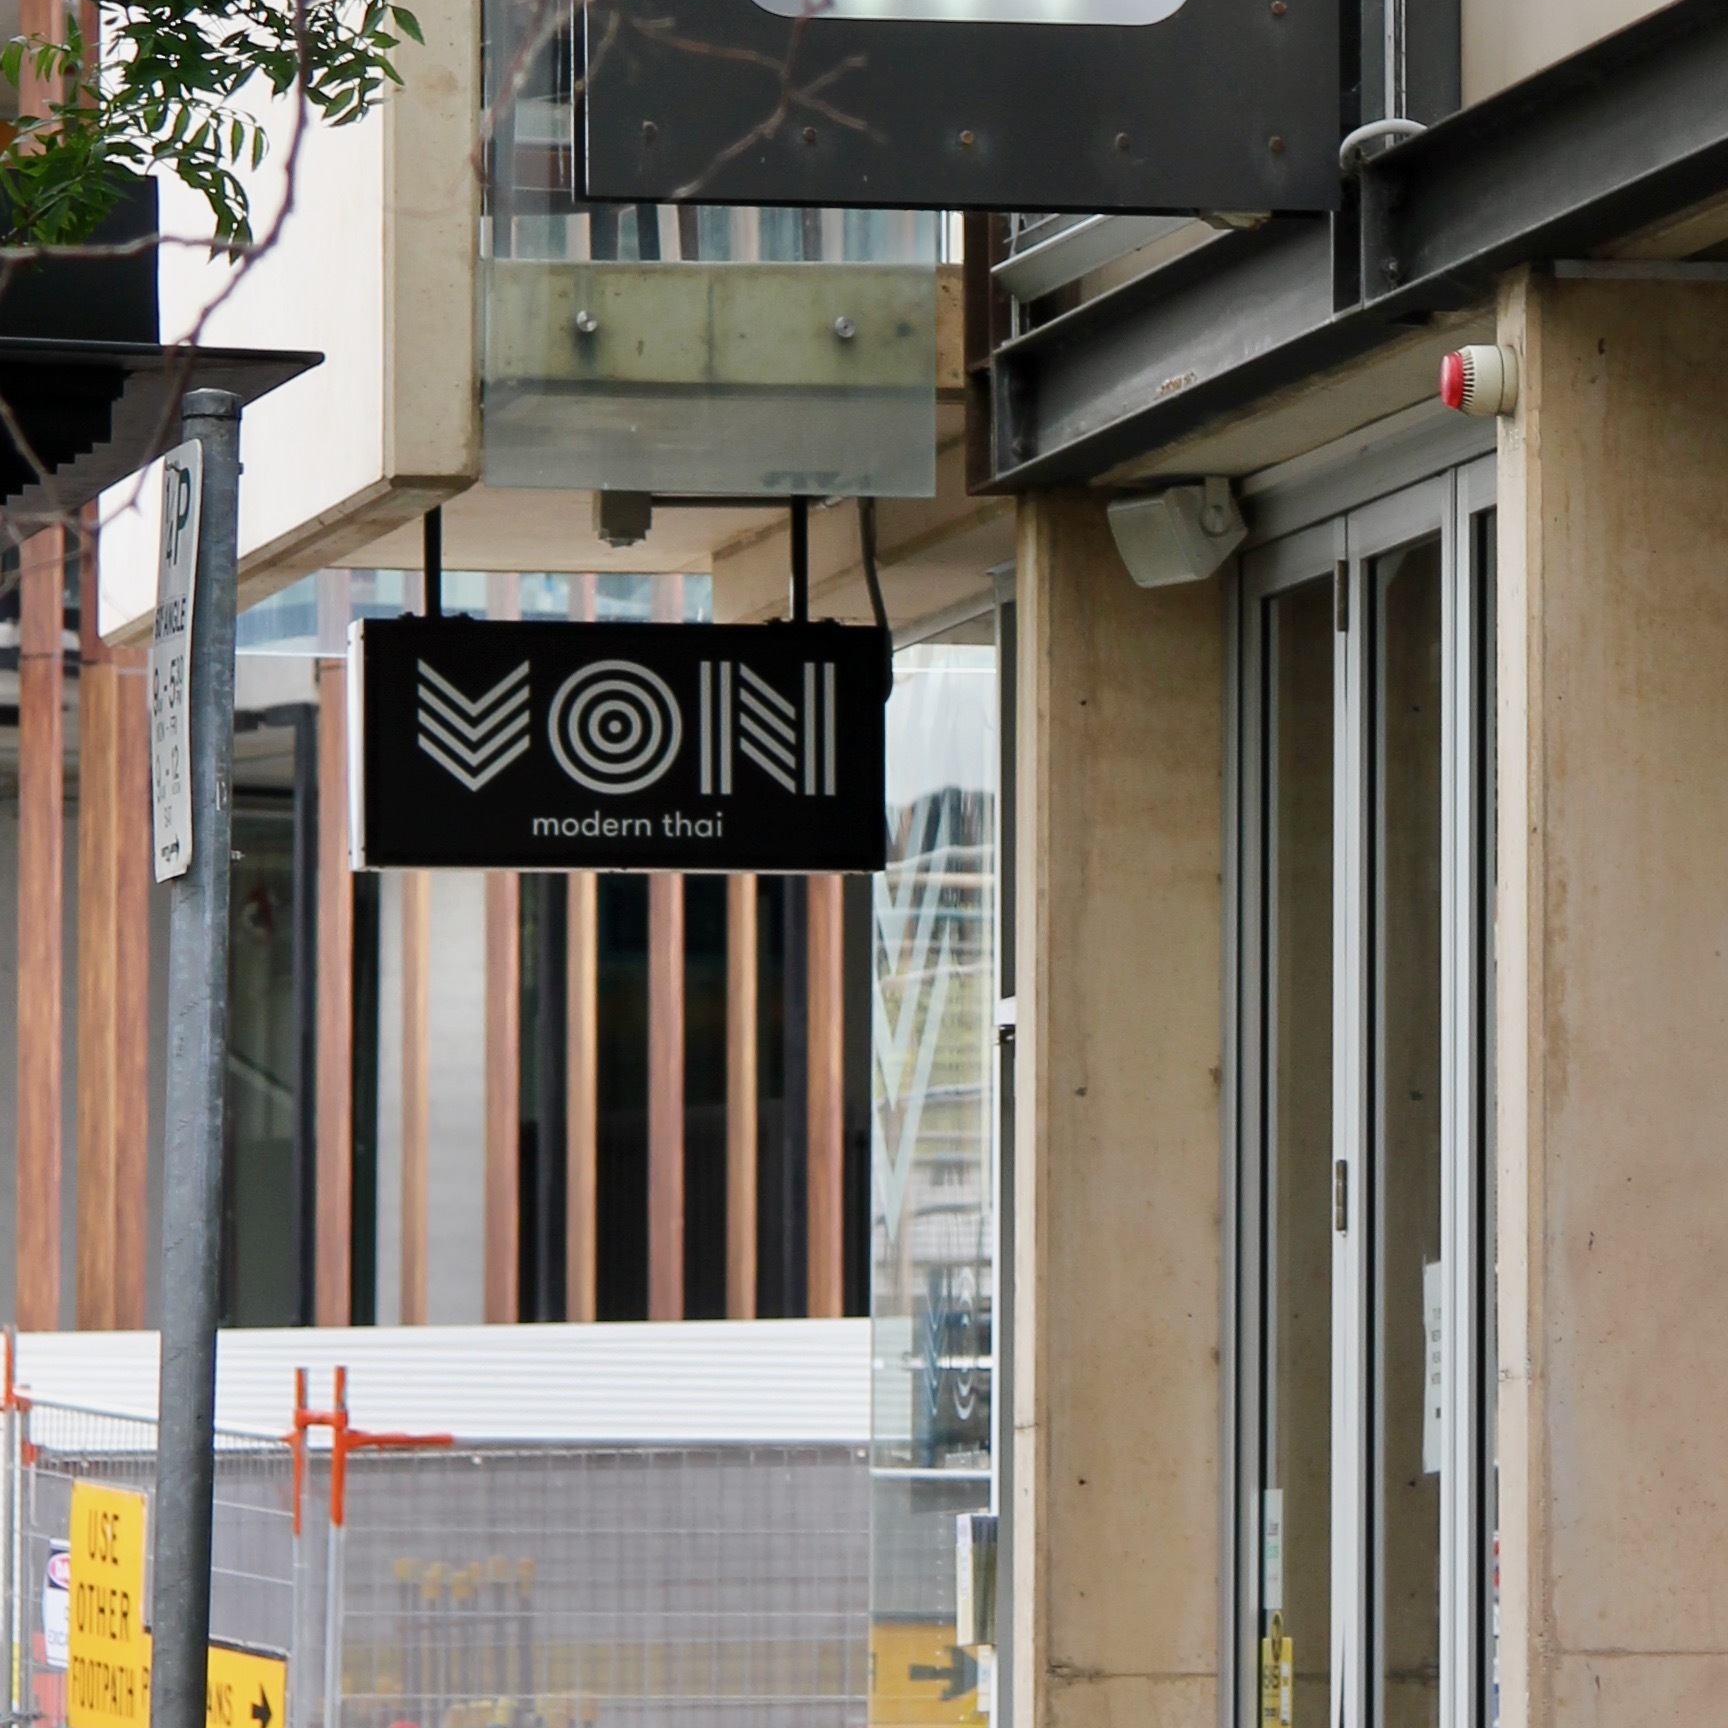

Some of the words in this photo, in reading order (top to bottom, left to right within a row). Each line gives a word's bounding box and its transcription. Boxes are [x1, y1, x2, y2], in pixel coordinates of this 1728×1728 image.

[417, 658, 837, 797] VON
[532, 810, 652, 838] modern
[662, 811, 723, 838] thai
[88, 1509, 119, 1565] USE
[76, 1581, 131, 1641] OTHER
[72, 1655, 136, 1719] FOOTPATH
